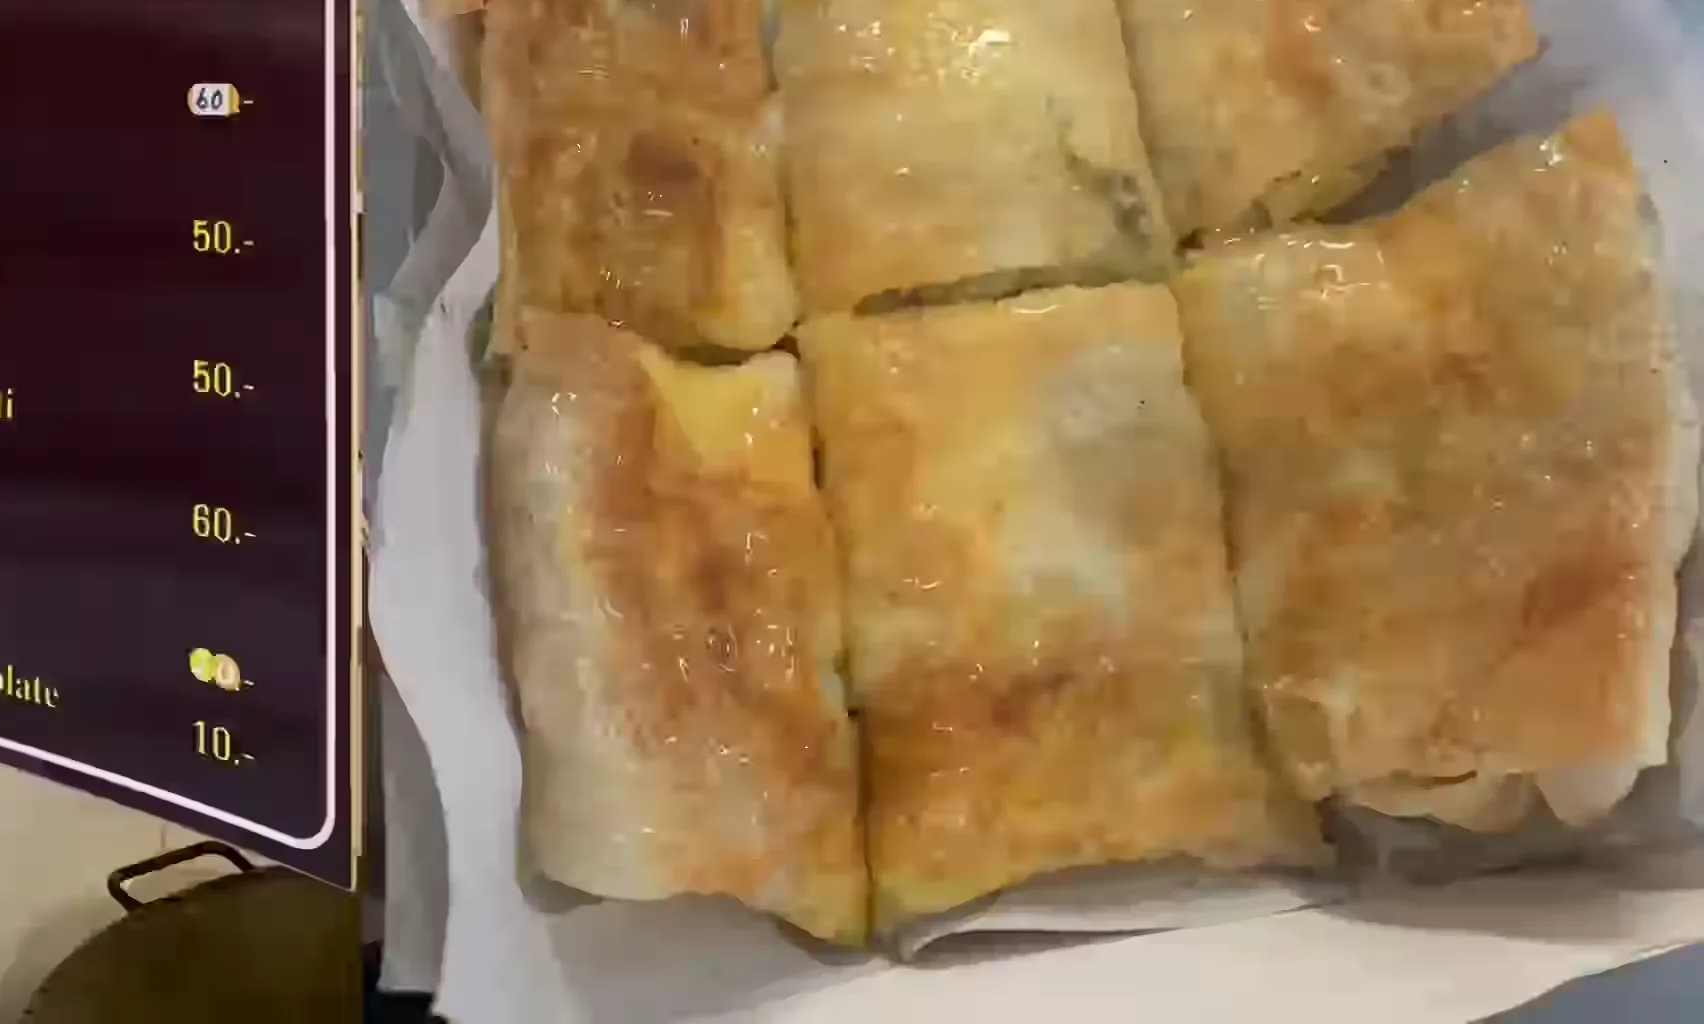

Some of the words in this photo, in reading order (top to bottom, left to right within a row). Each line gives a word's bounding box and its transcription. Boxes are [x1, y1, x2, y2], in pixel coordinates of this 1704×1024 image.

[193, 219, 255, 255] 50.-
[193, 359, 255, 399] 50.-
[193, 503, 256, 545] 60.-
[192, 720, 255, 765] 10.-
